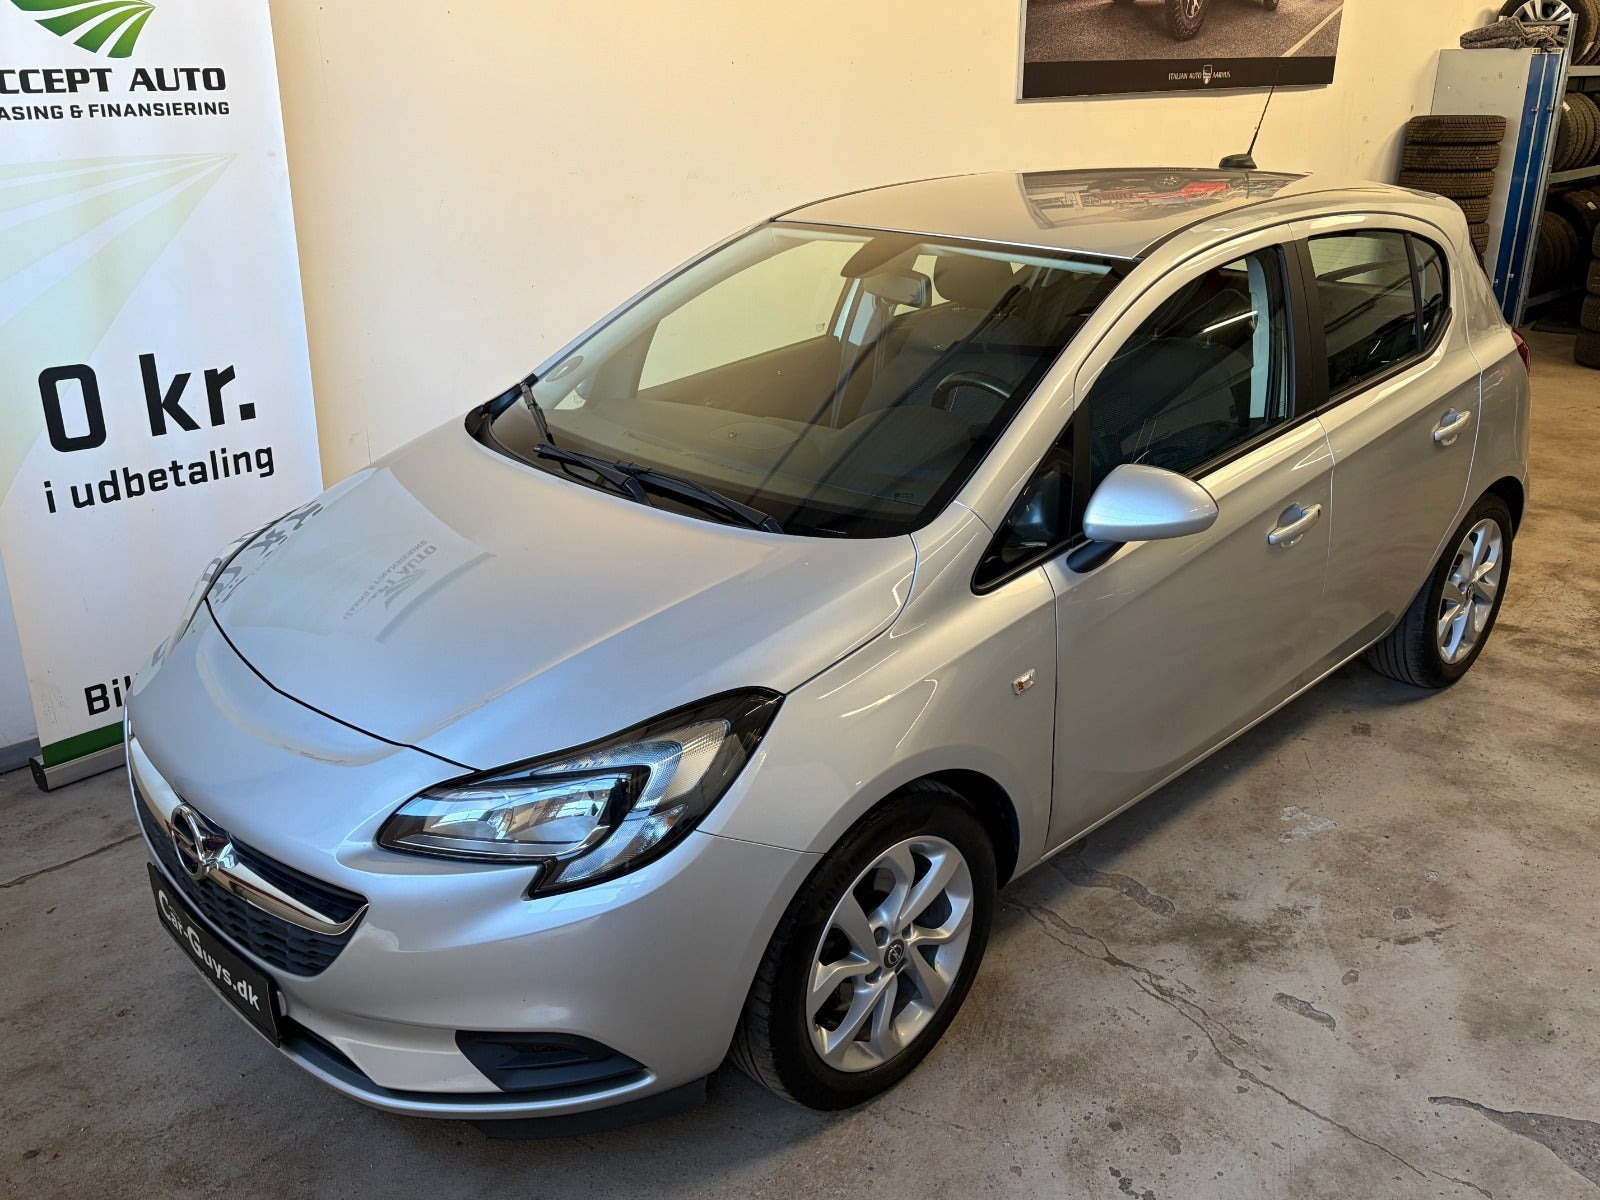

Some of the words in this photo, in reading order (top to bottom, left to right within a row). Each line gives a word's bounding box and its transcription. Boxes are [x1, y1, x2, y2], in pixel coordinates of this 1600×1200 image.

[70, 105, 84, 119] &
[89, 101, 230, 118] FINANSIERING
[128, 67, 226, 92] AUTO
[139, 353, 257, 437] kr.
[44, 481, 57, 514] i
[70, 446, 275, 509] udbetaling
[158, 889, 261, 1012] Car-Guys.dk
